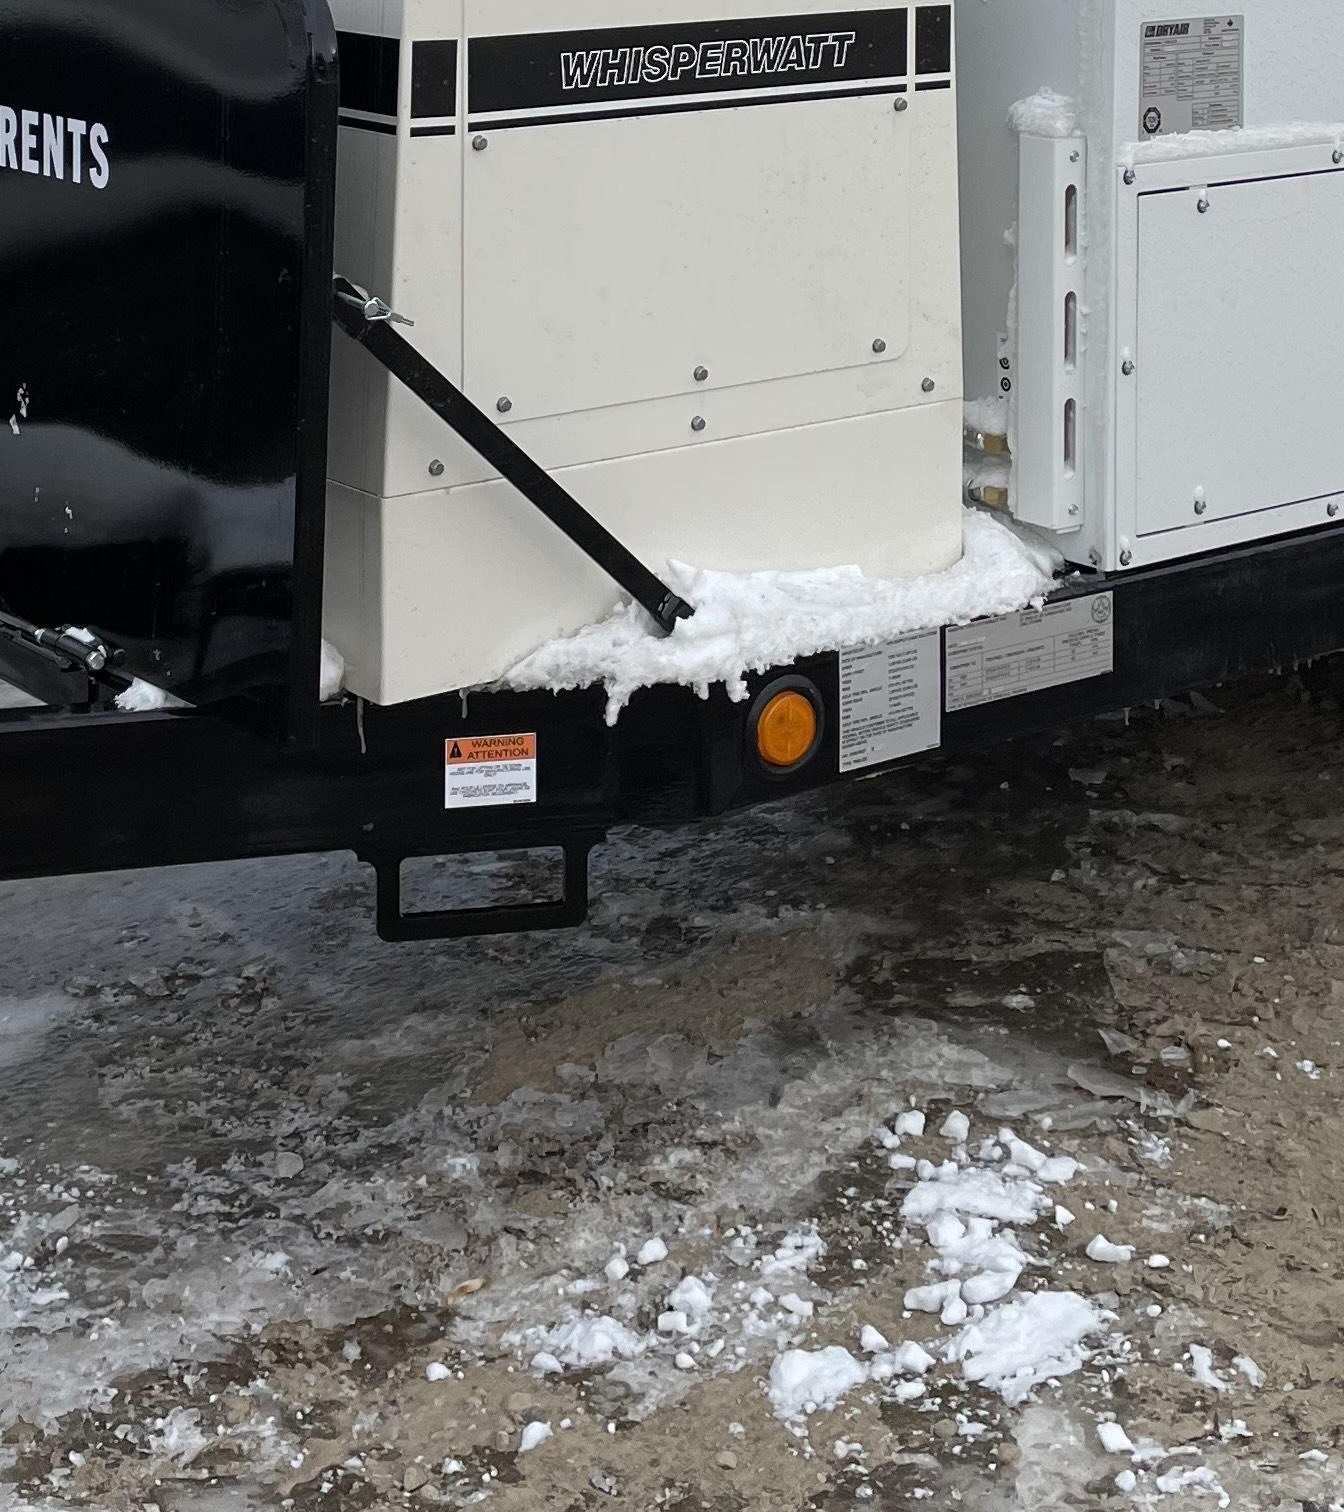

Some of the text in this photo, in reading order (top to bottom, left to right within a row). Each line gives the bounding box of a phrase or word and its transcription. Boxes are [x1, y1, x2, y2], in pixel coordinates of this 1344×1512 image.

[560, 32, 856, 89] WHISPERWATT
[471, 736, 525, 749] WARNING
[467, 747, 530, 761] ATTENTION
